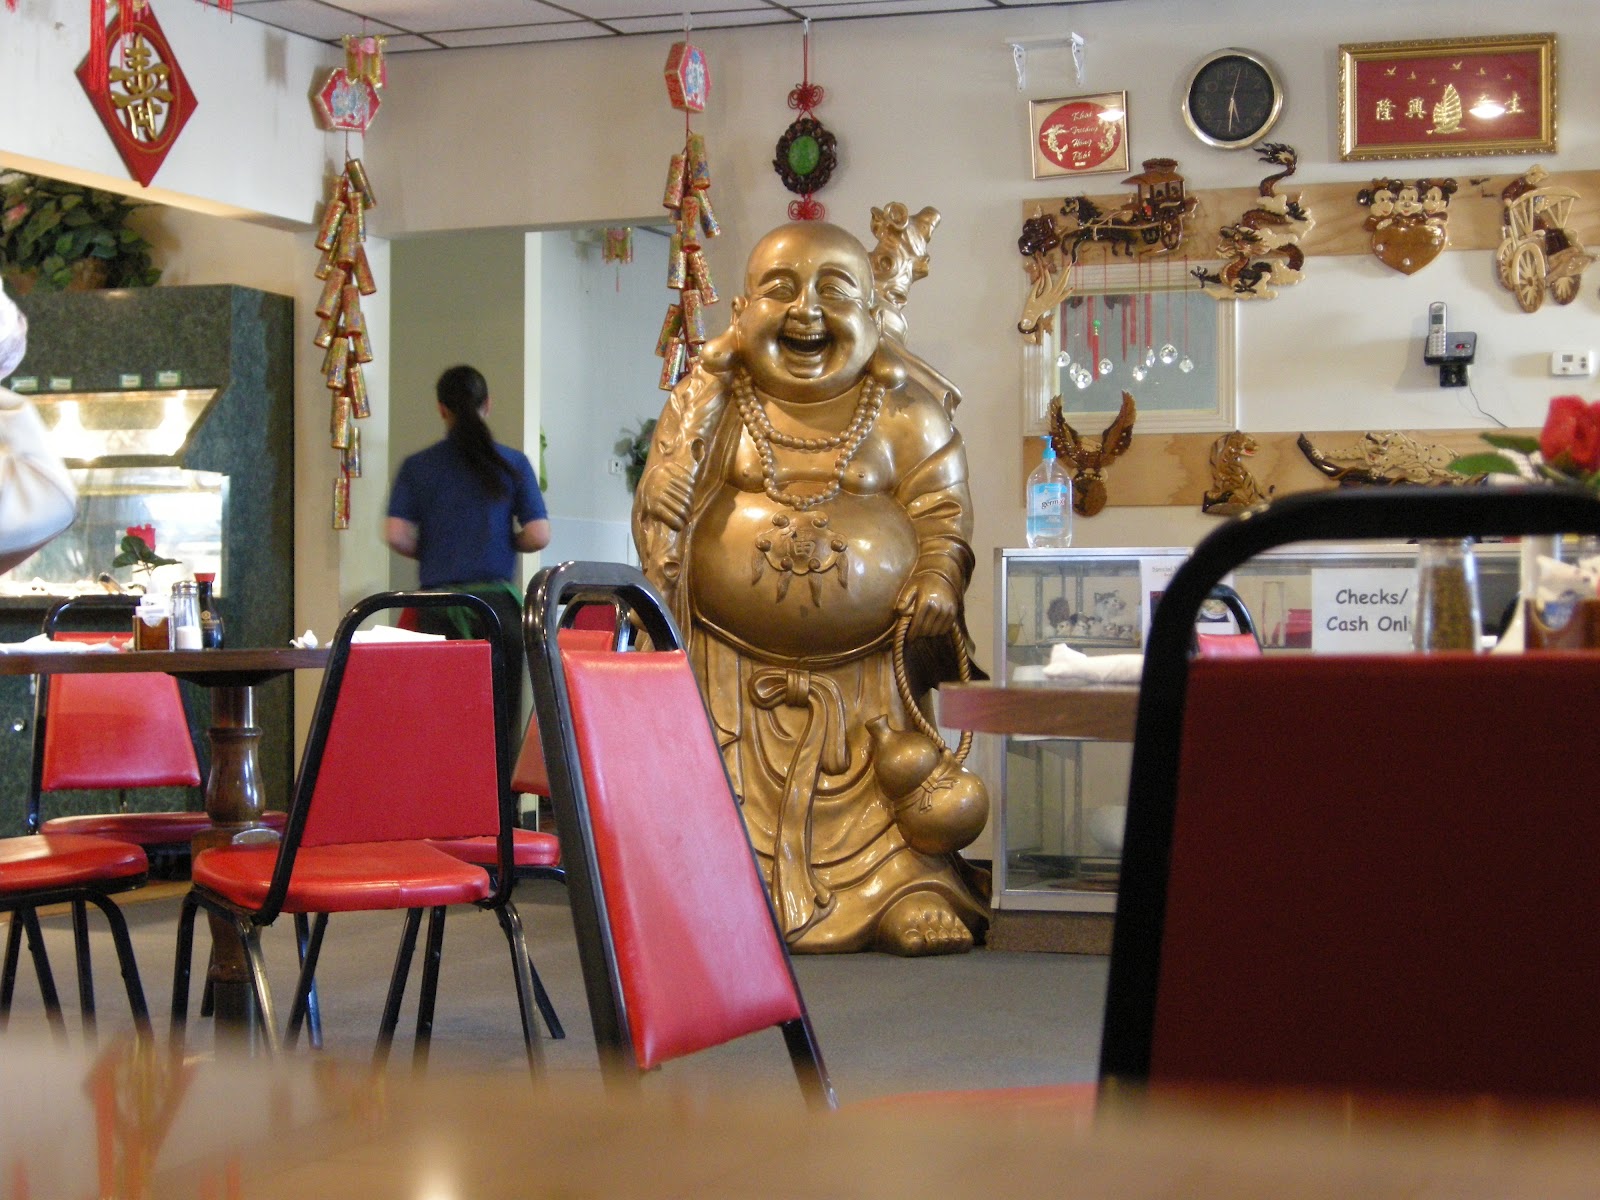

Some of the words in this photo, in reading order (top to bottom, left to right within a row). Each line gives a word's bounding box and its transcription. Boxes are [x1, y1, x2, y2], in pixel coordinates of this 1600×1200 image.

[1335, 587, 1409, 605] Checks/
[1326, 615, 1369, 631] Cash
[1377, 615, 1411, 632] Onl
